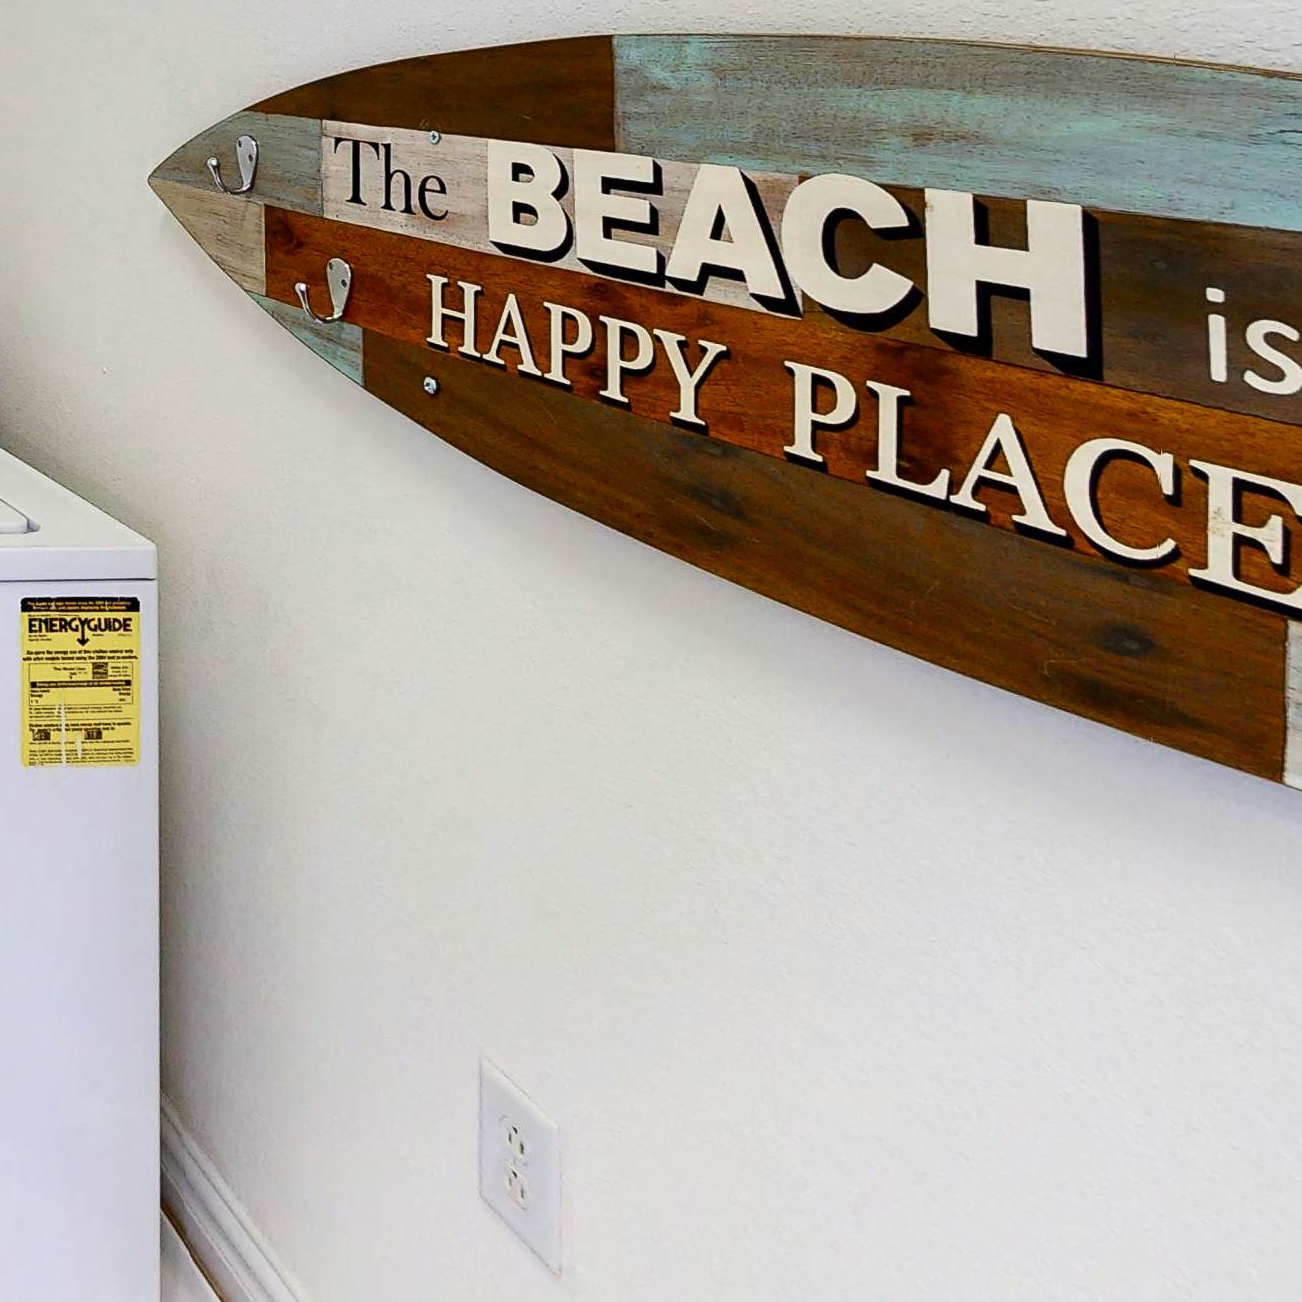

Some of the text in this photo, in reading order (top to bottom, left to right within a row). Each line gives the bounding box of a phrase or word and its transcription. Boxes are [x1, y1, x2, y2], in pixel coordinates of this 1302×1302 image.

[332, 135, 1302, 395] The BEACH is
[426, 274, 1302, 609] HAPPY PLACE
